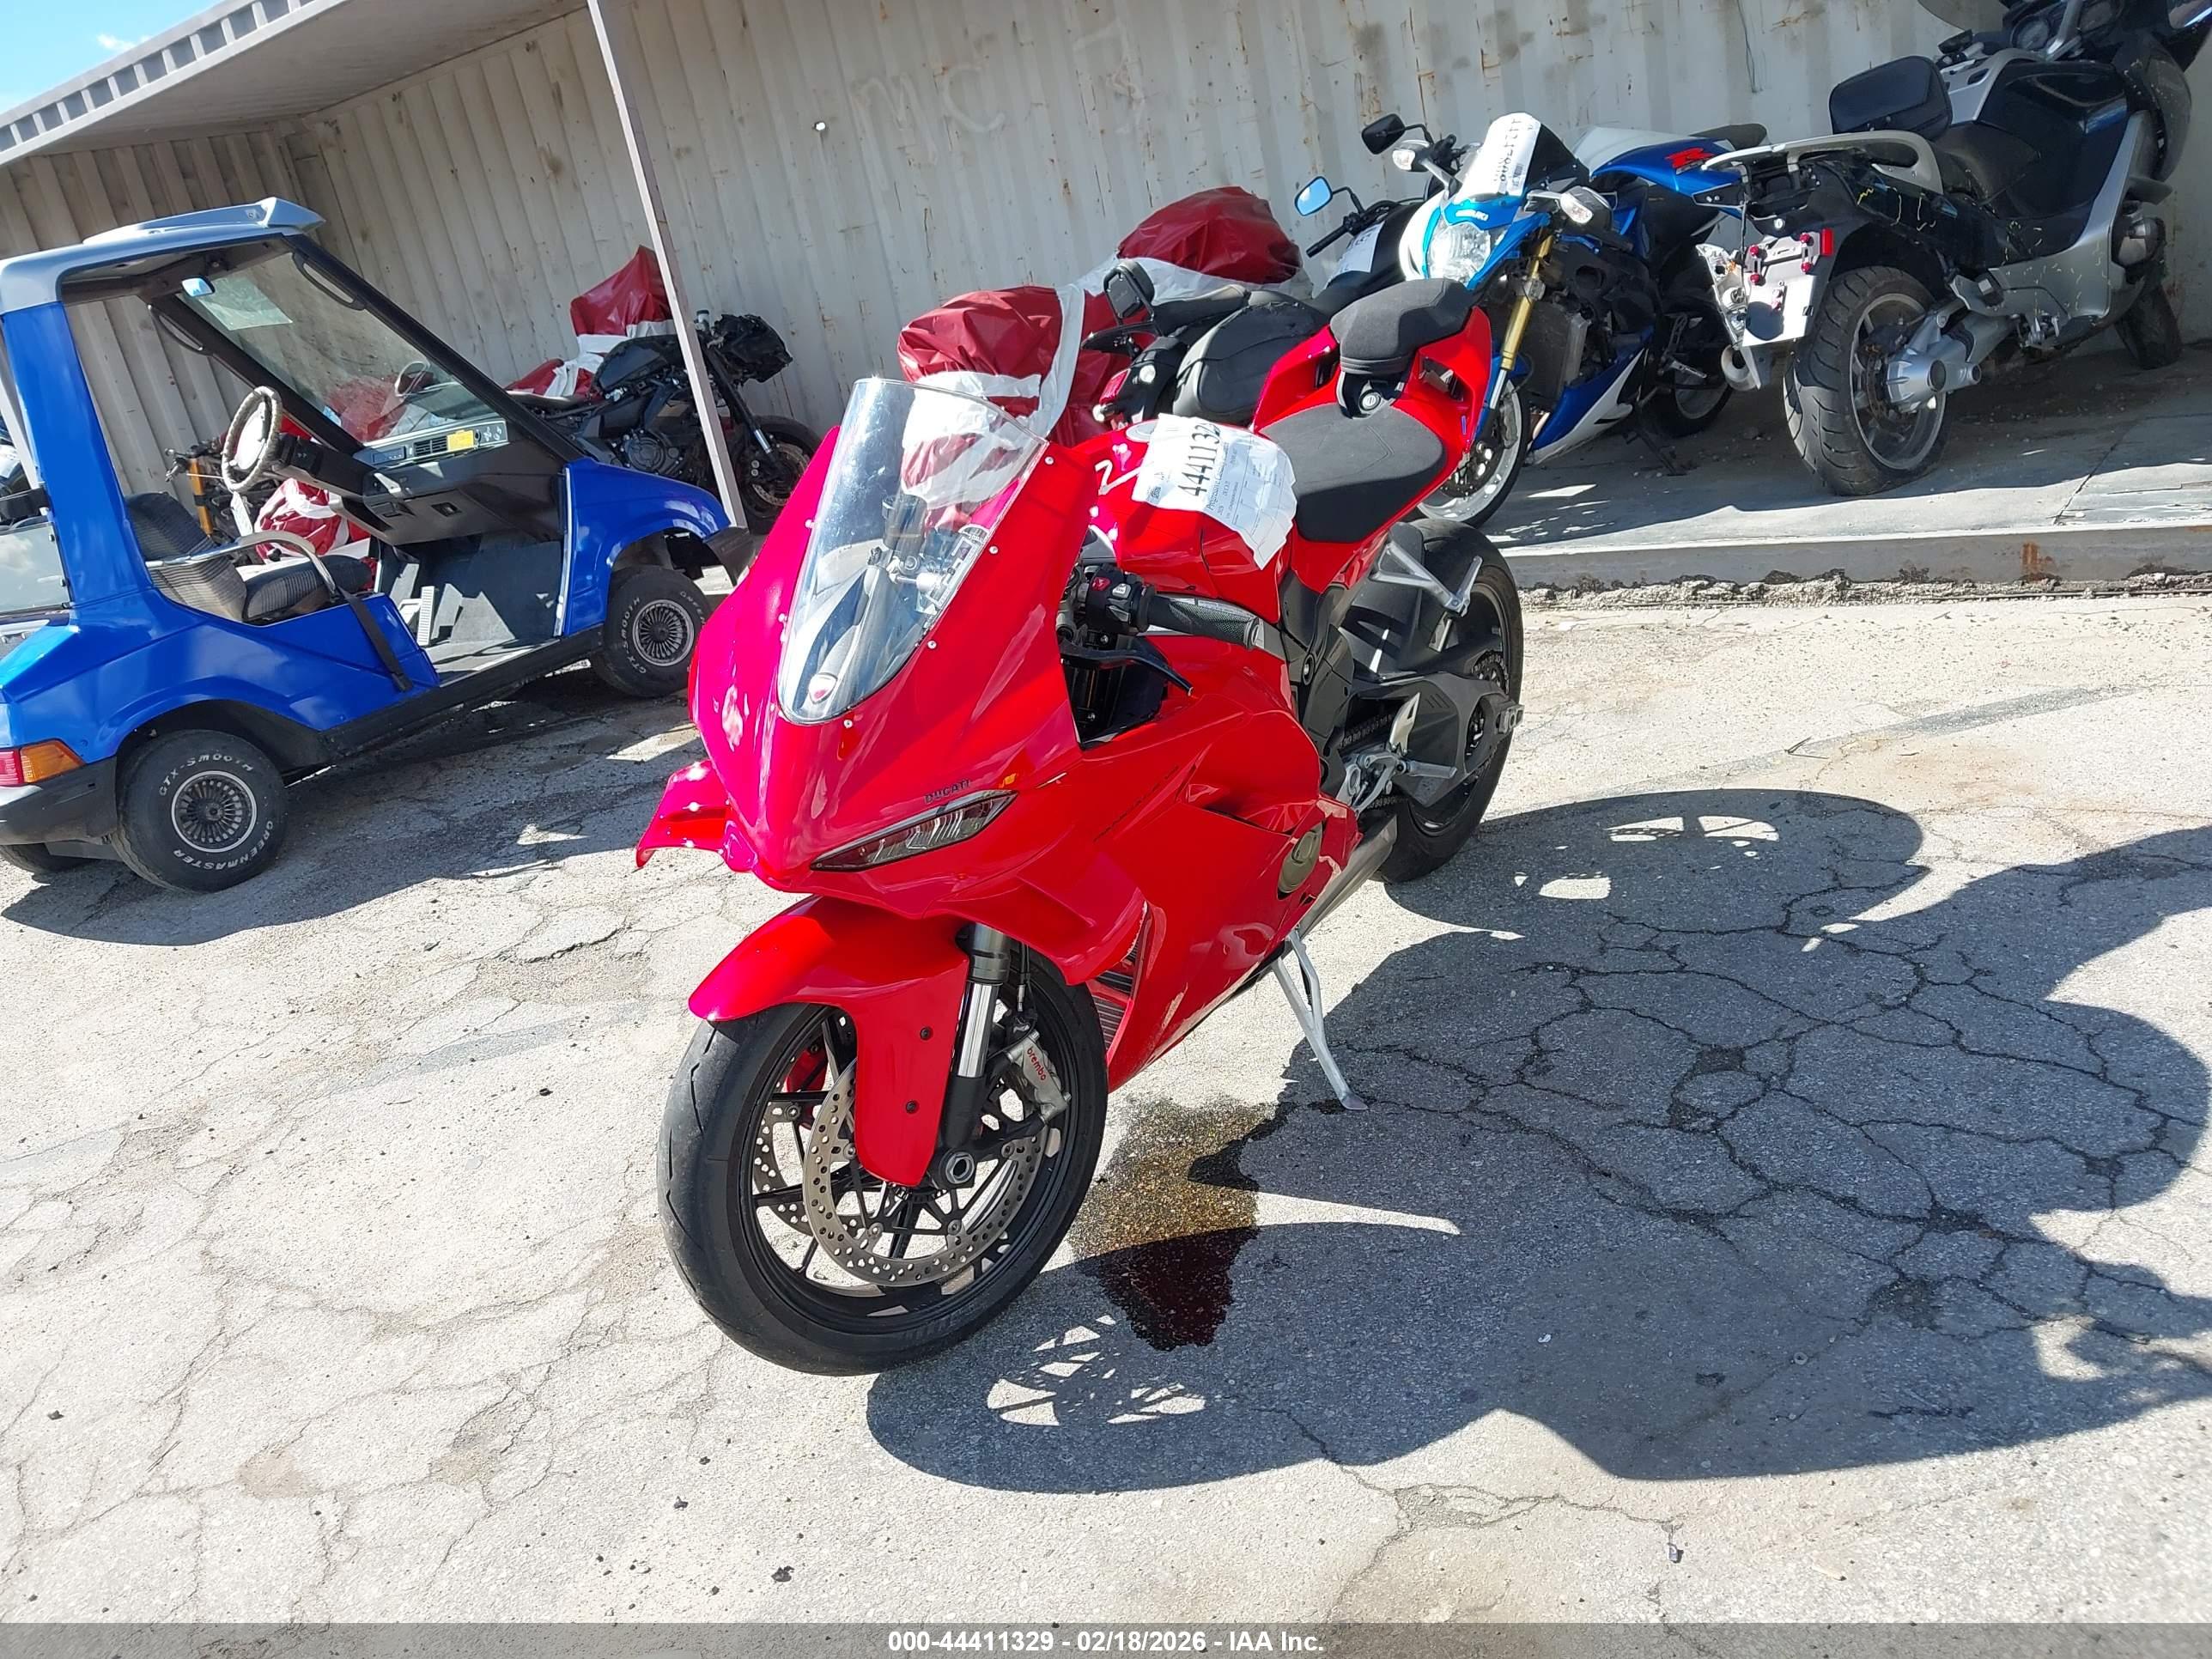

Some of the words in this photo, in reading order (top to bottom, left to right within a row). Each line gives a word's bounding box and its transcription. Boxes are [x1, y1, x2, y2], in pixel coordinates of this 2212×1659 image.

[924, 779, 970, 805] DUCATI
[173, 820, 274, 871] GREENMASTER
[1026, 1045, 1047, 1081] brembo
